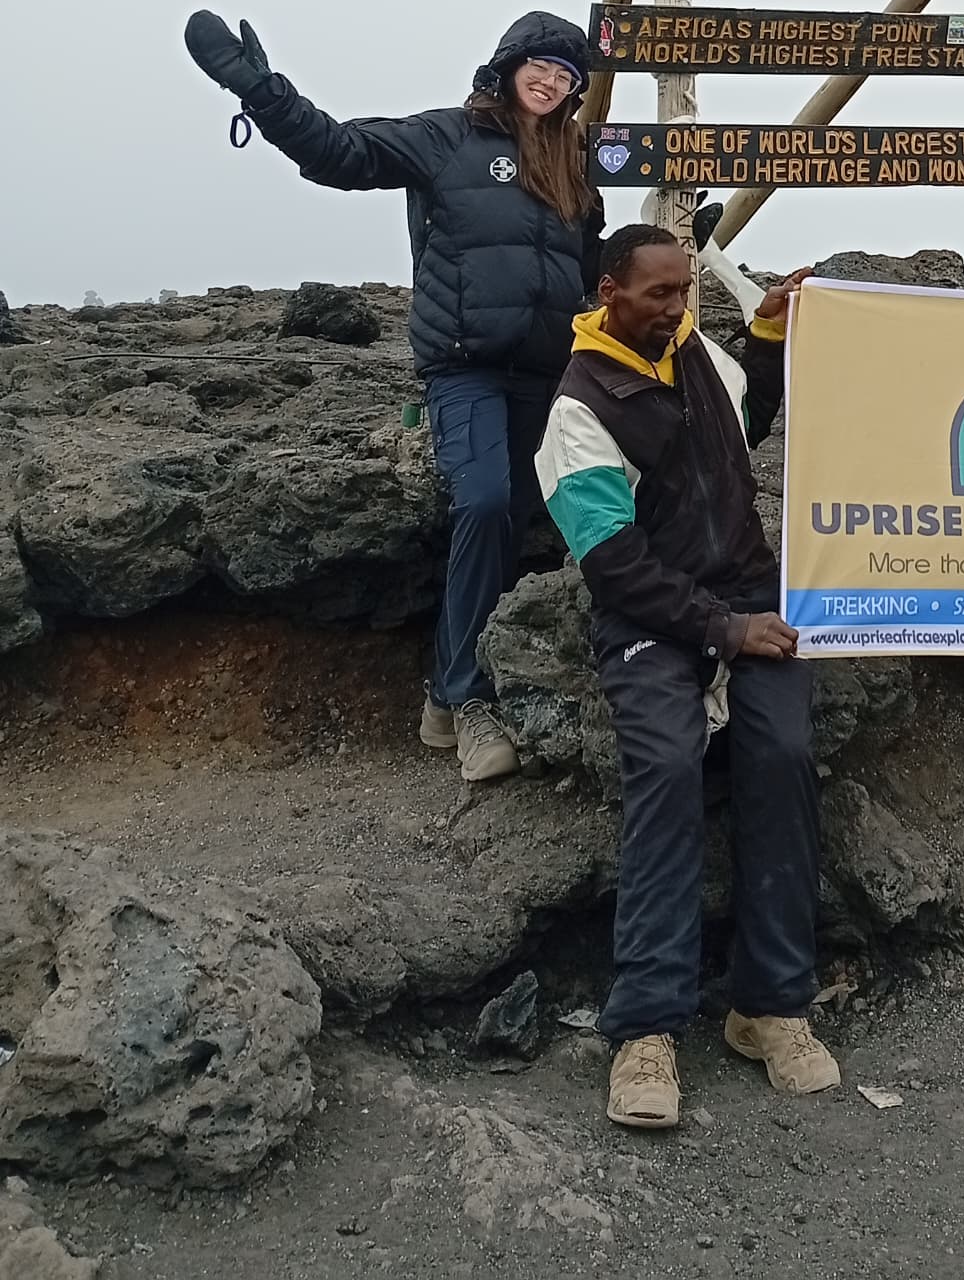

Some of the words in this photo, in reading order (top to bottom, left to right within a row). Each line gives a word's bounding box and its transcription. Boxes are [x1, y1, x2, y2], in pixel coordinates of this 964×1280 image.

[638, 16, 752, 40] AFRICAS
[759, 20, 861, 42] HIGHEST
[871, 22, 939, 44] POINT
[634, 42, 741, 65] WORLD'S
[749, 44, 857, 67] HIGHEST
[665, 128, 716, 154] ONE
[722, 130, 752, 154] OF
[758, 130, 857, 155] WORLD'S
[603, 151, 622, 166] KC
[664, 157, 749, 184] WORLD
[755, 158, 870, 183] HERITAGE
[877, 159, 920, 183] AND
[811, 502, 963, 537] UPRISE
[868, 552, 931, 577] More
[821, 596, 919, 616] TREKKING
